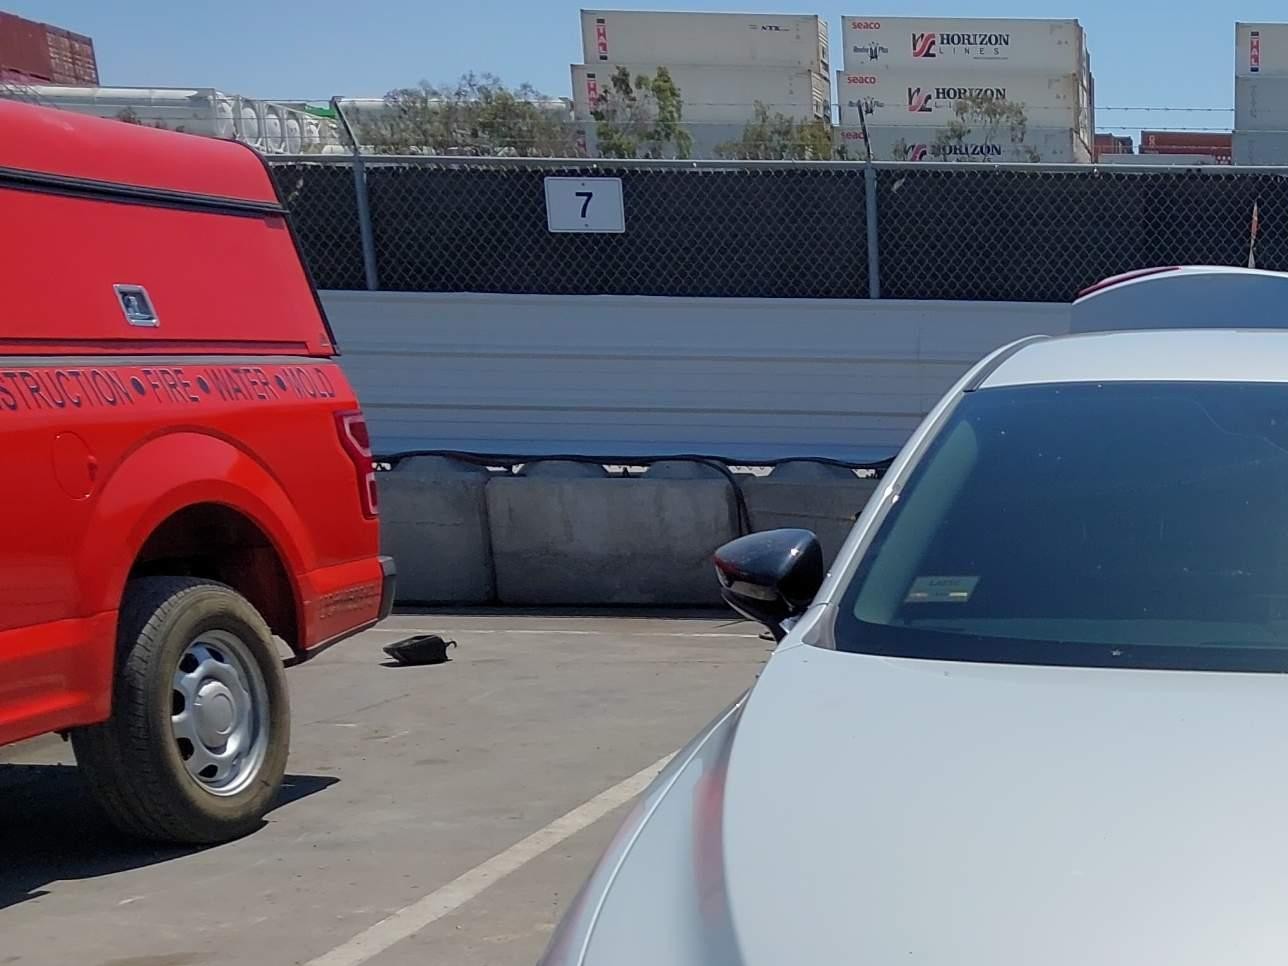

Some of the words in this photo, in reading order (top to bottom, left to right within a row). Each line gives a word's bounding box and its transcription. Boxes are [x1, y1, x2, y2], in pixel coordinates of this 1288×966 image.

[852, 21, 881, 30] seaco
[939, 33, 1010, 46] HORIZON
[939, 47, 1000, 55] LINES
[1250, 38, 1260, 66] TAL
[847, 75, 876, 85] seaco
[935, 87, 1007, 100] HORIZON
[841, 131, 868, 140] seac
[575, 192, 593, 218] 7
[142, 367, 200, 404] FIRE
[205, 367, 281, 401] WATER
[282, 367, 336, 399] MOLD
